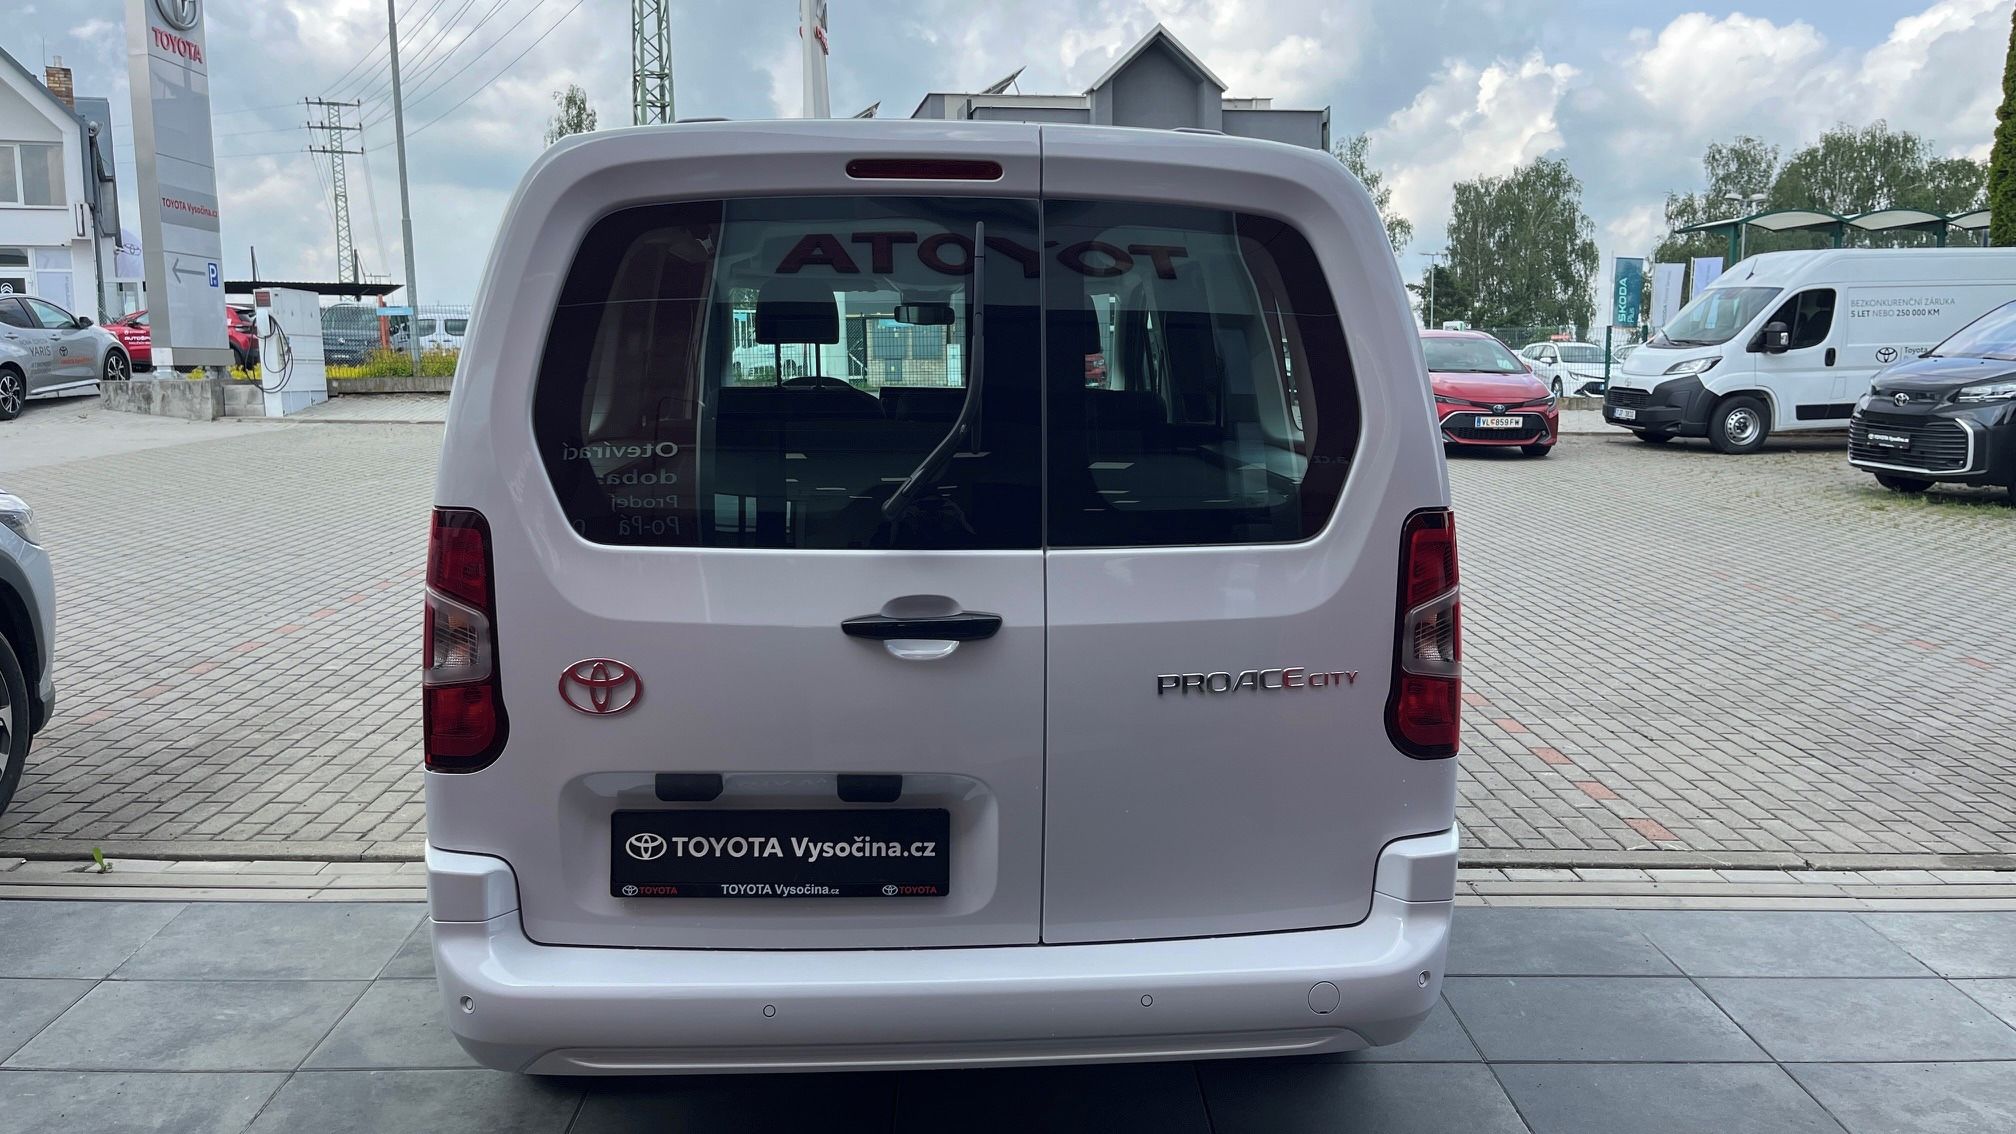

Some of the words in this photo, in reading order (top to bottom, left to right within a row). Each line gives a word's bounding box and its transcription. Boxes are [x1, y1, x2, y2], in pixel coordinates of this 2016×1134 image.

[151, 26, 203, 64] TOYOTA
[162, 197, 187, 212] TOYOTA
[1850, 298, 1923, 308] BEZKONKURENČNÍ
[1924, 297, 1955, 306] ZÁRUKA
[1857, 310, 1870, 318] LET
[1872, 309, 1894, 317] NEBO
[1896, 309, 1911, 317] 250
[1927, 308, 1940, 316] KM
[29, 345, 52, 357] YARIS
[1904, 346, 1928, 355] Toyota
[1481, 418, 1490, 426] VL
[1157, 666, 1305, 695] PROACE
[1308, 669, 1359, 688] CITY
[672, 836, 784, 858] TOYOTA
[790, 835, 936, 863] Vysočina.cz
[639, 885, 678, 895] TOYOTA
[721, 884, 772, 895] TOYOTA
[774, 883, 840, 897] Vysočina.cz
[899, 885, 937, 895] TOYOTA
